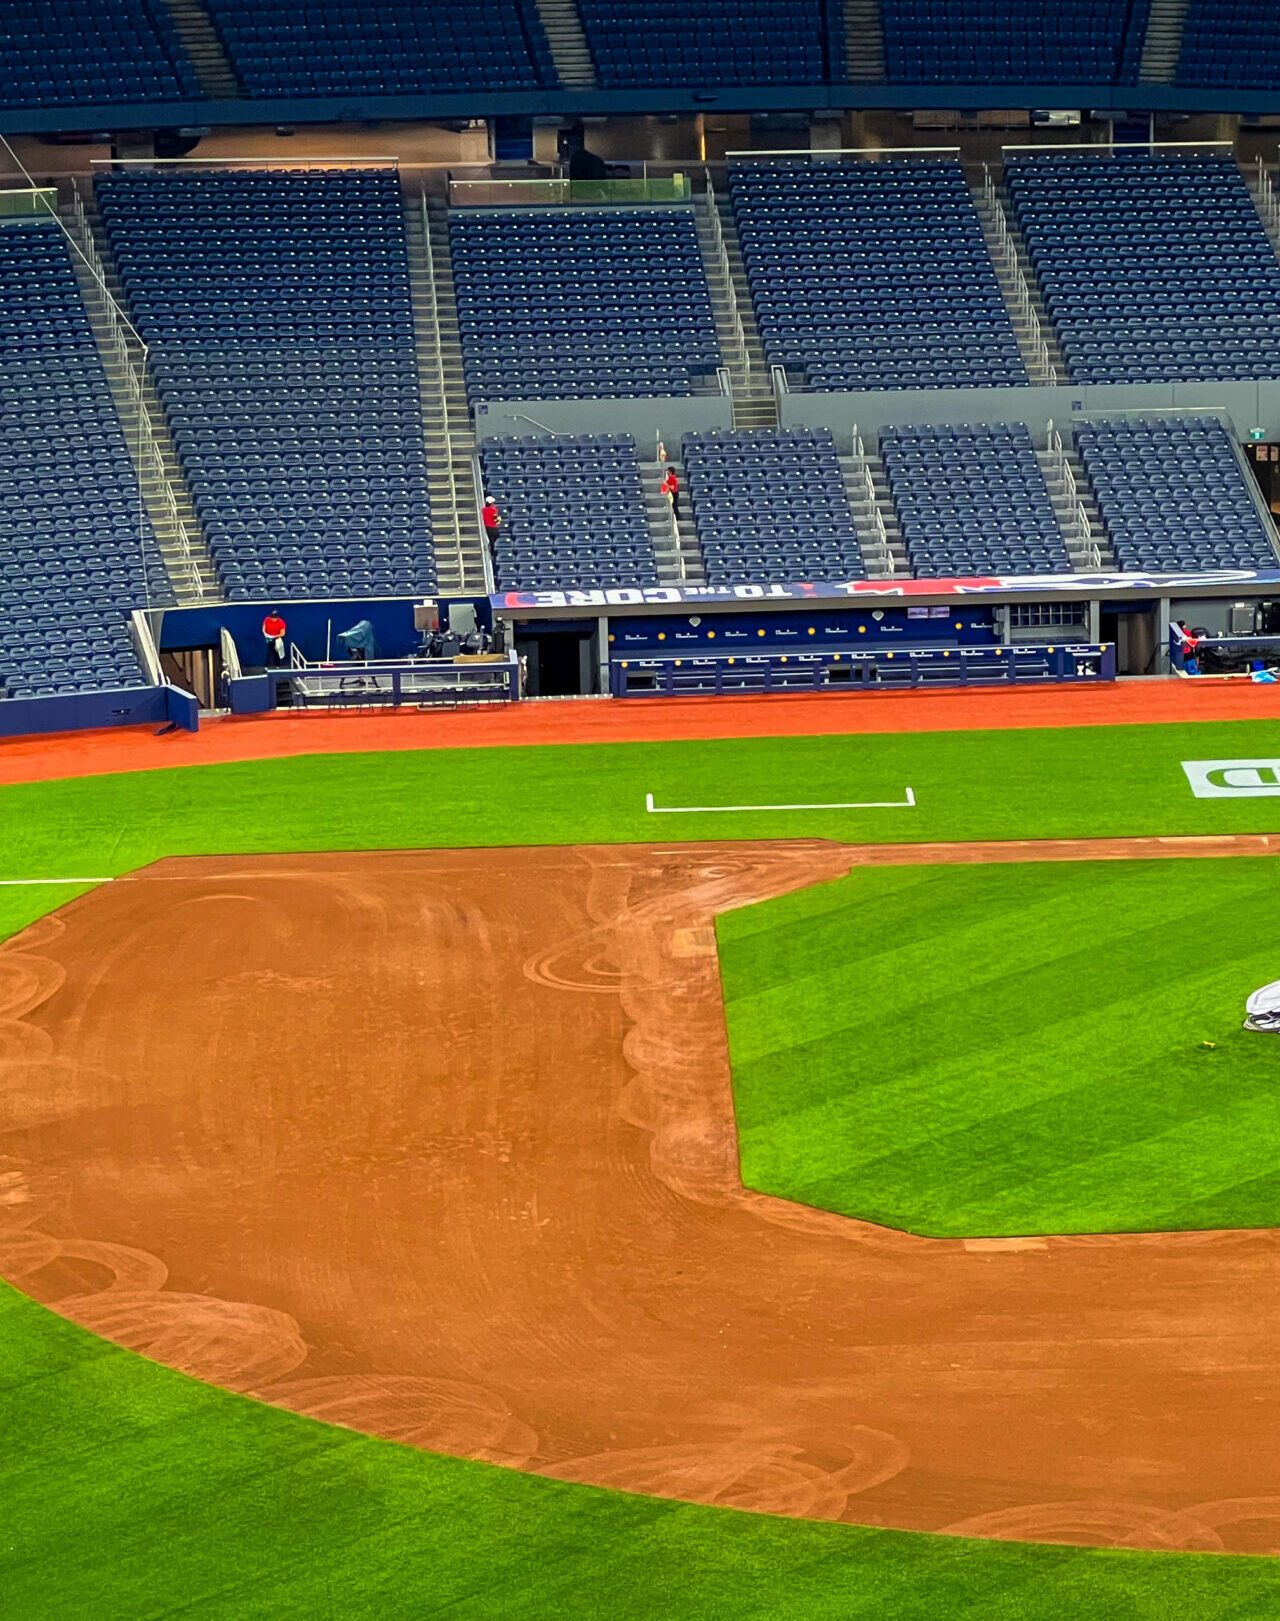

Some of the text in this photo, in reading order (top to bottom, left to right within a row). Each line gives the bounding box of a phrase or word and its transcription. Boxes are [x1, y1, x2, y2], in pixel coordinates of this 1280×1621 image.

[532, 584, 793, 607] TO THE CORE
